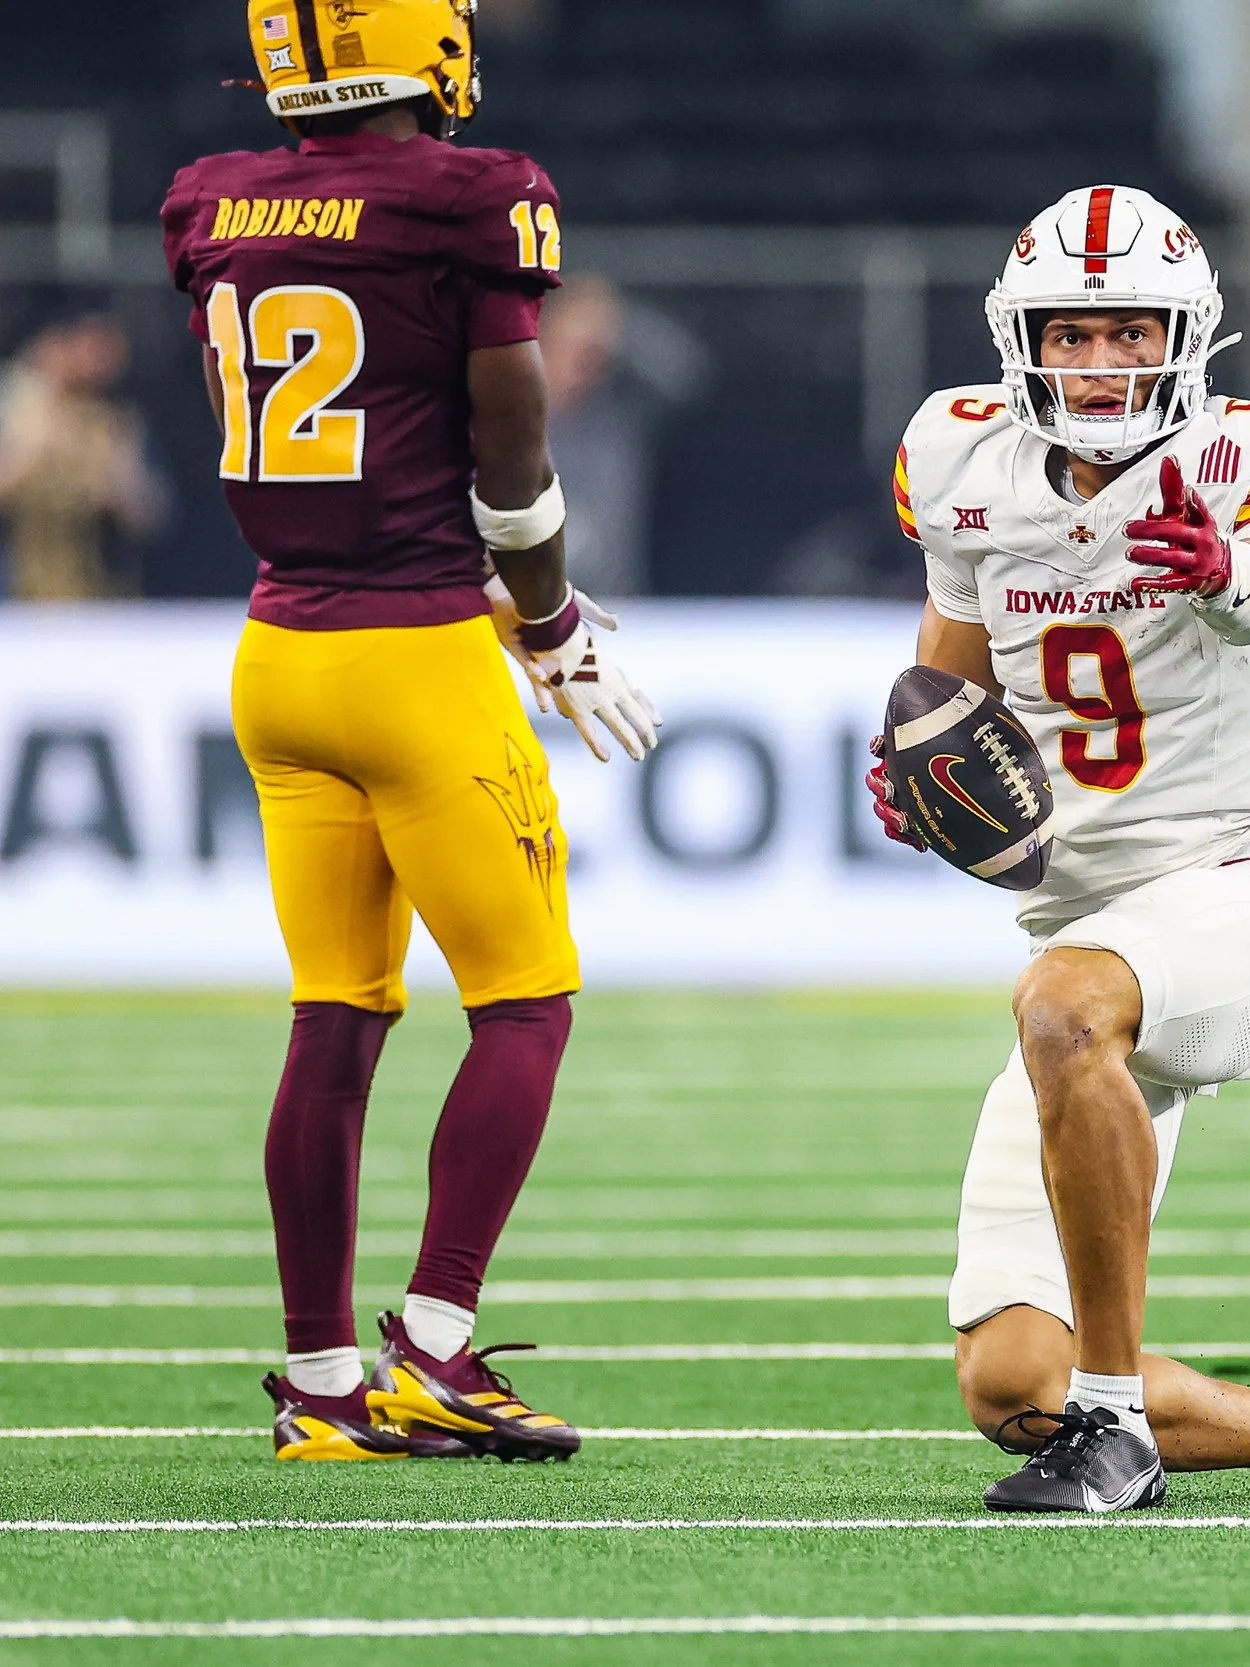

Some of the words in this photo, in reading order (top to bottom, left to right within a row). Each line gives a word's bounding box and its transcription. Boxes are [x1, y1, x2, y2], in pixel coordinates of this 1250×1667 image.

[276, 89, 332, 111] ARIZONA
[335, 81, 390, 101] STATE
[209, 197, 365, 242] ROBINSON
[508, 200, 561, 271] 12
[206, 281, 365, 482] 12
[952, 506, 991, 533] XII
[1005, 588, 1077, 615] IOWA
[1040, 622, 1148, 794] 9
